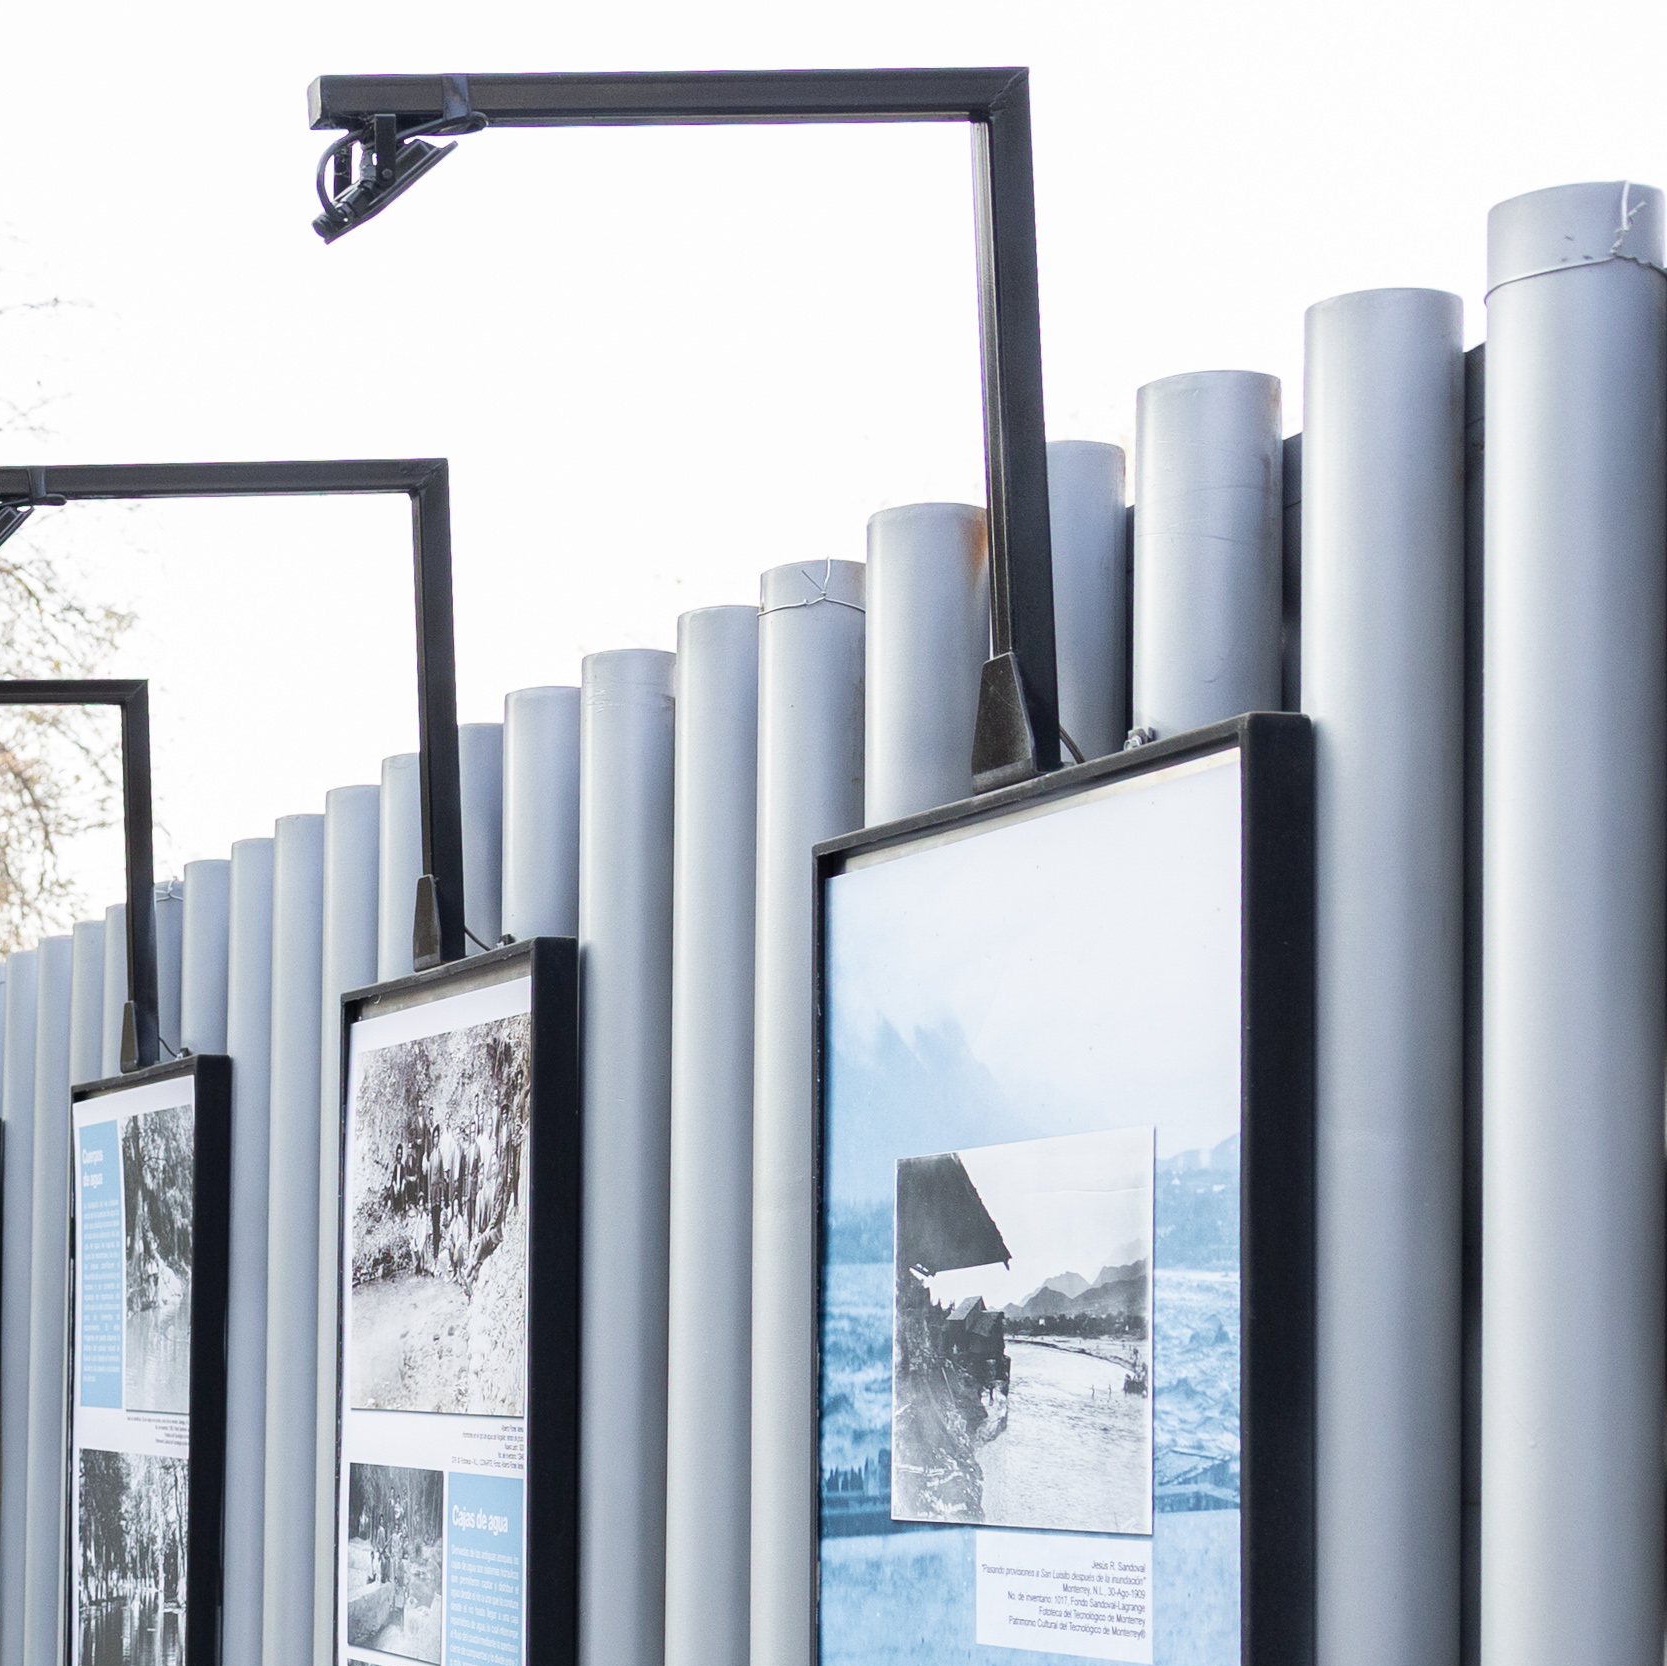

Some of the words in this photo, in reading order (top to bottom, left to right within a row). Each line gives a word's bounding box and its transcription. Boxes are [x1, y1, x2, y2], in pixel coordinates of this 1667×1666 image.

[452, 1504, 475, 1531] Cajas
[476, 1507, 487, 1530] de
[488, 1514, 508, 1536] agua
[1041, 1569, 1051, 1578] San
[1096, 1573, 1104, 1583] de
[1091, 1560, 1108, 1570] Jesús
[1118, 1561, 1146, 1573] Sandoval
[1018, 1592, 1024, 1601] de
[1071, 1596, 1088, 1607] Fondo
[1089, 1598, 1146, 1614] Sandoval-Lagrange
[1037, 1618, 1058, 1629] Cultural
[1059, 1621, 1067, 1630] del
[1069, 1621, 1101, 1635] Tecnológico
[1103, 1626, 1110, 1635] de
[1039, 1606, 1062, 1617] Fototeca
[1063, 1609, 1072, 1619] del
[1073, 1609, 1106, 1623] Tecnológico
[1107, 1613, 1114, 1622] de
[1116, 1614, 1145, 1628] Monterrey
